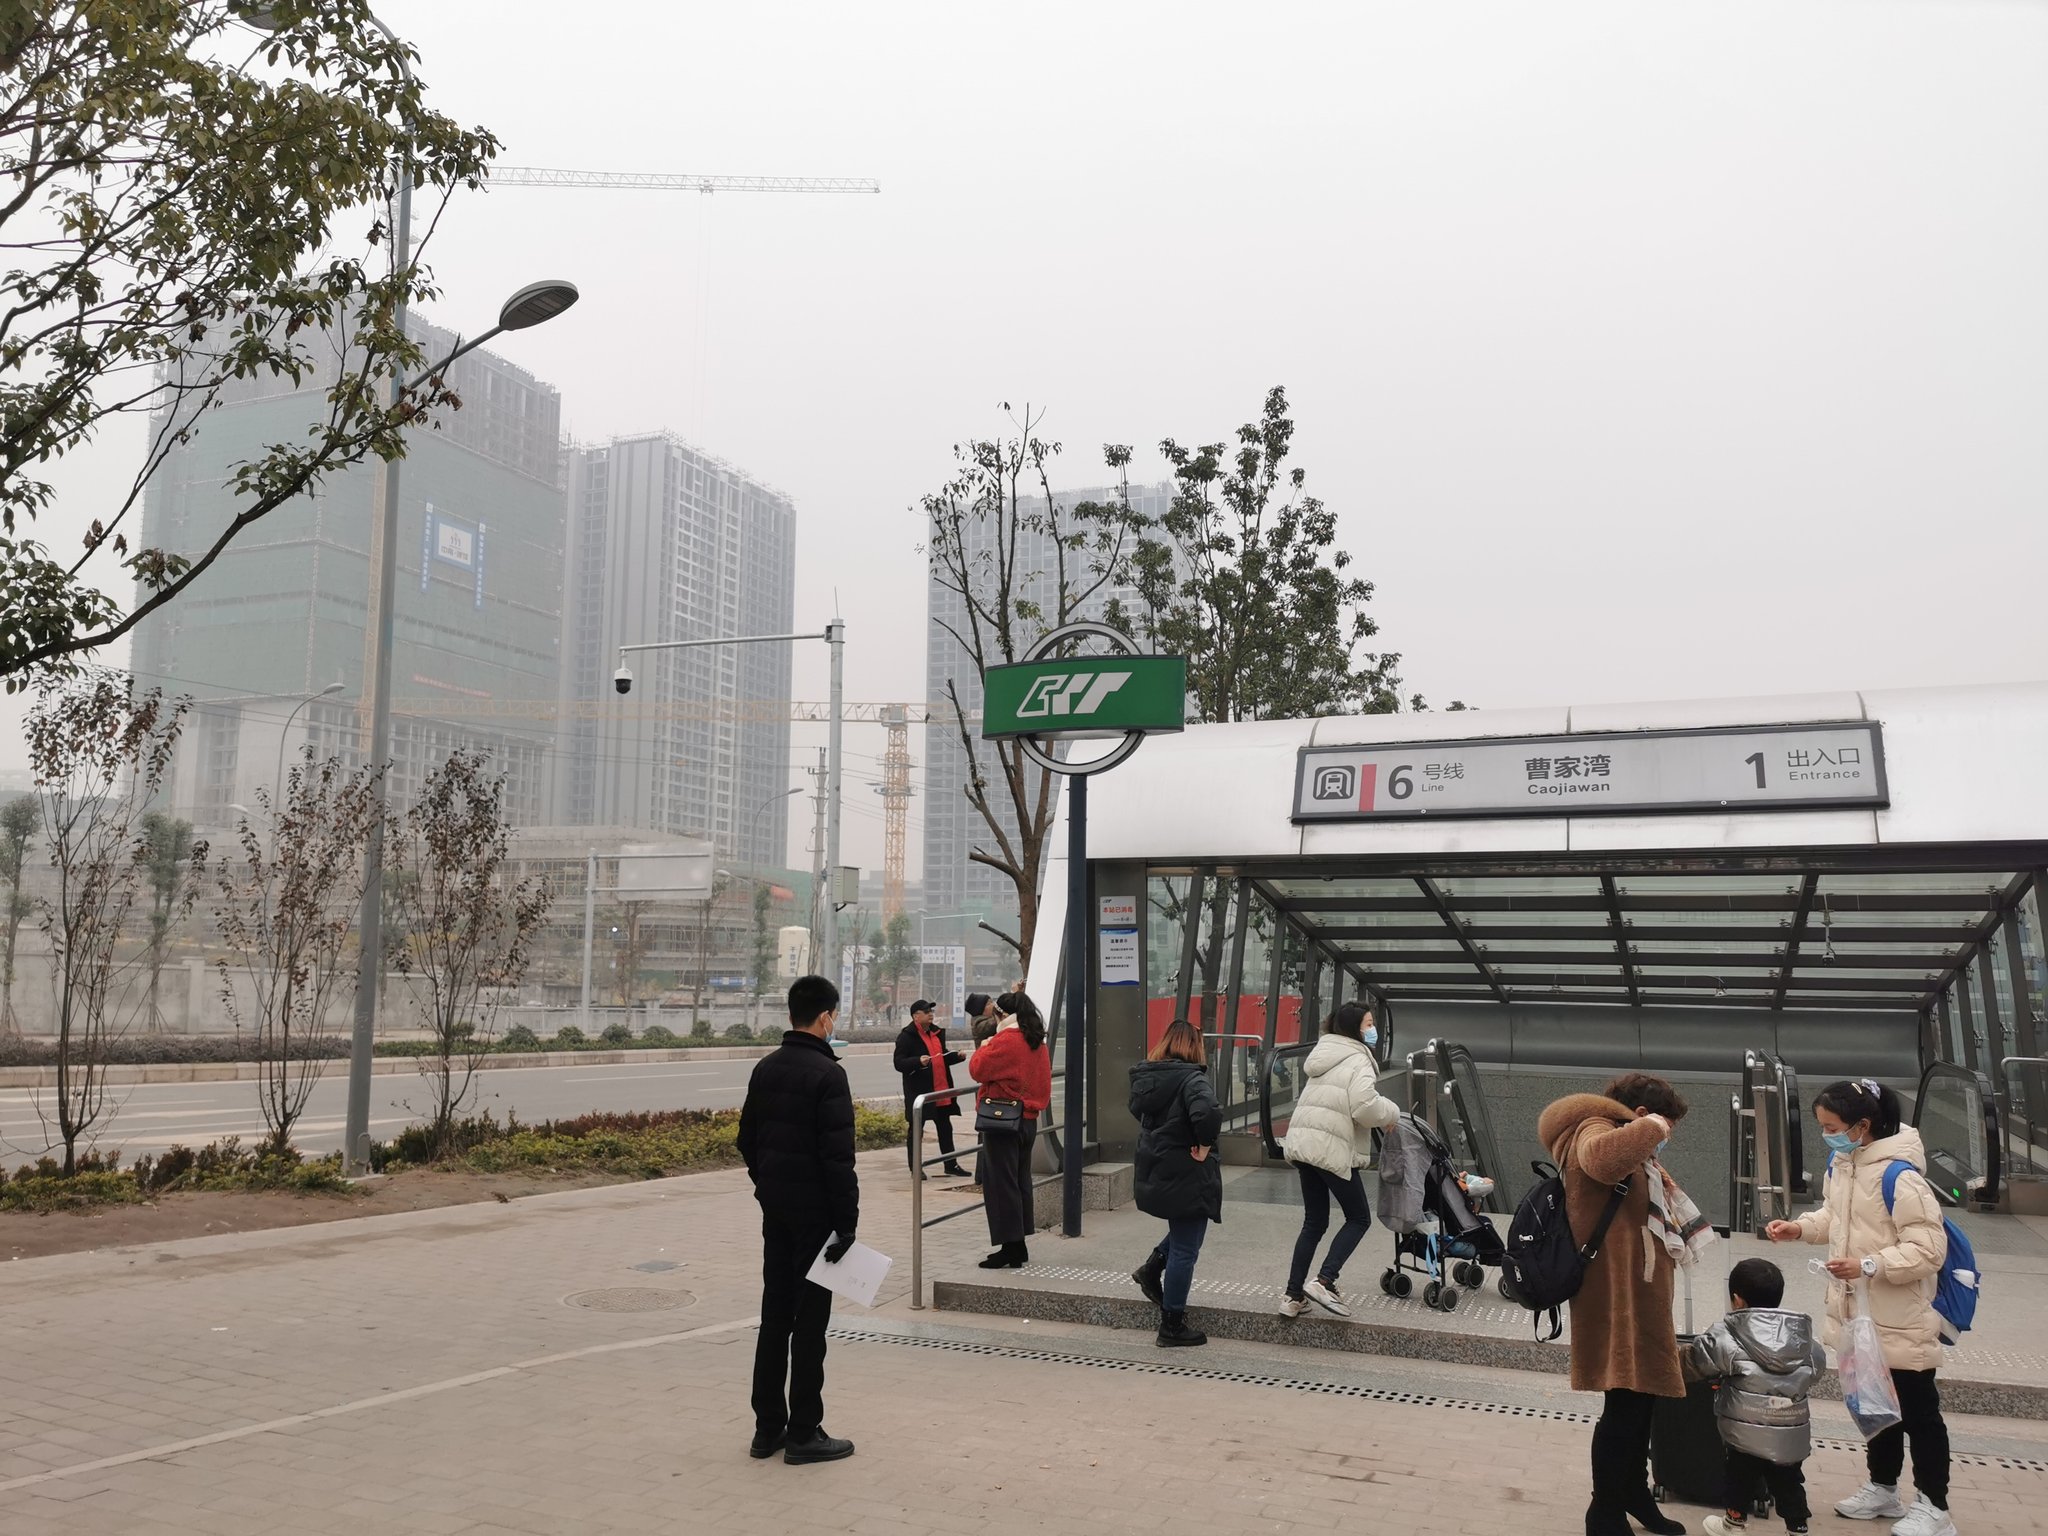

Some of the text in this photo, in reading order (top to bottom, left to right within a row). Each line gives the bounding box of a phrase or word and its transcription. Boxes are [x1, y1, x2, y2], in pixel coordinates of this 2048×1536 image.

[1787, 748, 1861, 767] 出入口
[1422, 762, 1465, 780] 号线
[1524, 754, 1612, 780] 曹家湾
[1744, 752, 1767, 789] 1
[1789, 770, 1860, 780] Entrance
[1388, 765, 1414, 800] 6
[1421, 783, 1444, 792] Line
[1527, 783, 1610, 796] Caojiawan
